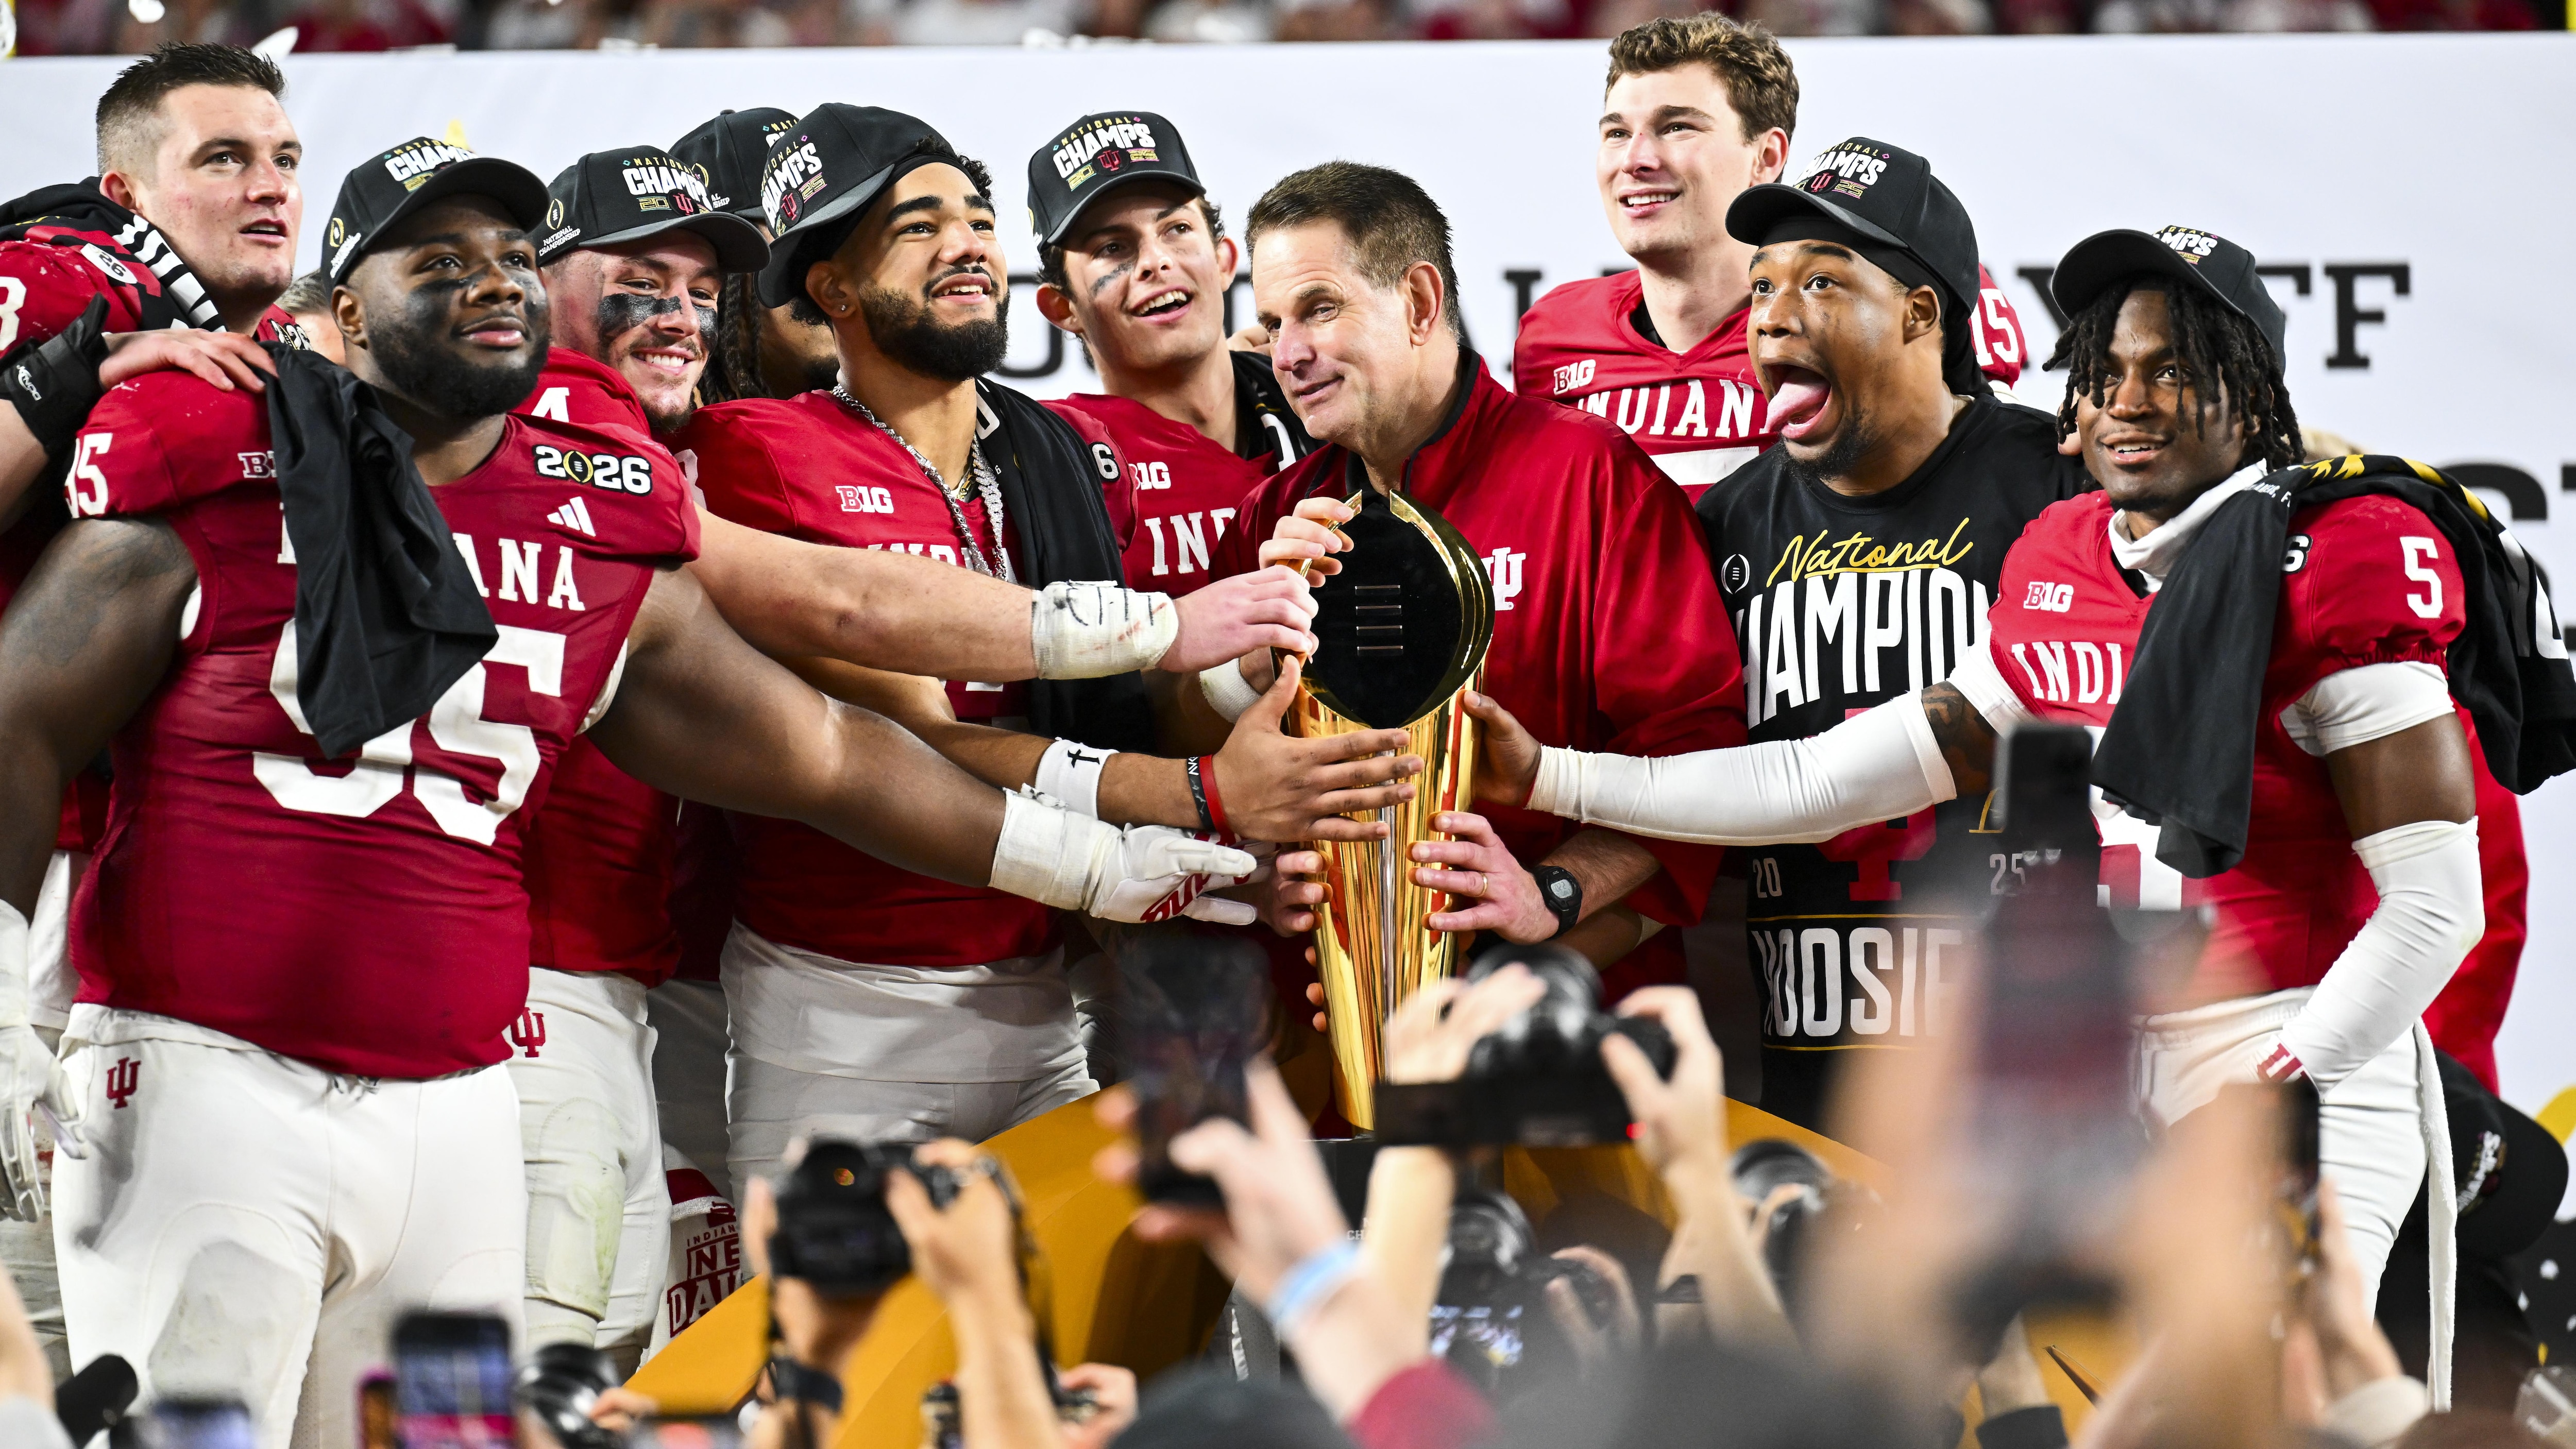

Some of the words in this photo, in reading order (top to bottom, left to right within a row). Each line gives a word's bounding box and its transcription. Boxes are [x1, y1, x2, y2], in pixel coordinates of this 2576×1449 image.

[1061, 116, 1131, 146] NATIONAL
[385, 145, 478, 181] CHAMP
[1053, 123, 1156, 178] CHAMPS
[800, 174, 826, 201] 25
[1067, 165, 1095, 190] 20
[639, 197, 670, 211] 20
[539, 228, 581, 256] CHAMPIONSHIP
[543, 226, 573, 246] NATIONAL
[1766, 517, 1974, 588] National
[2400, 536, 2443, 619] 5
[1753, 857, 1782, 898] 20
[107, 1057, 141, 1109] IU
[687, 1224, 736, 1247] INDIAN
